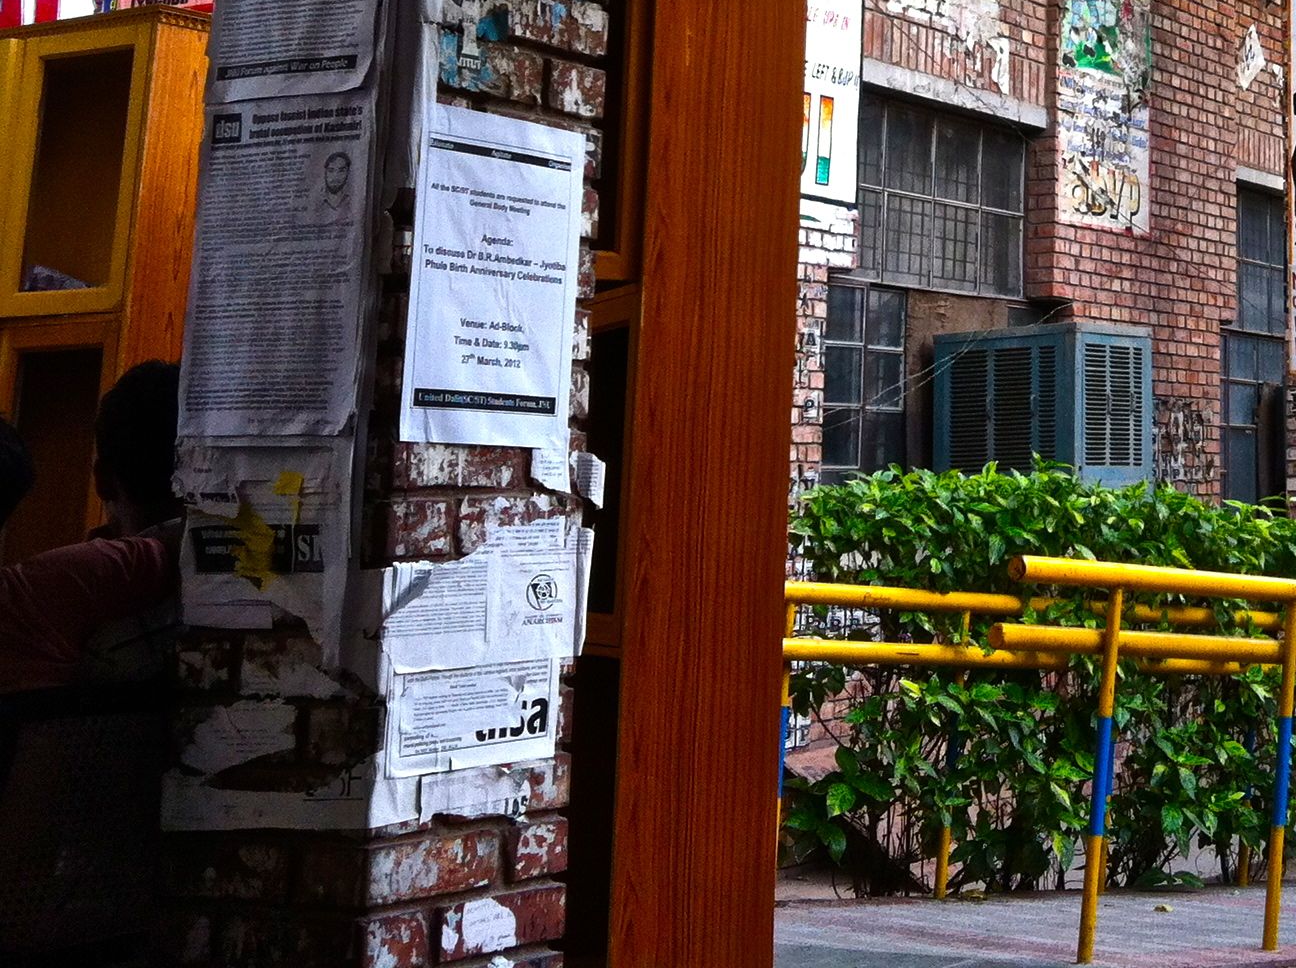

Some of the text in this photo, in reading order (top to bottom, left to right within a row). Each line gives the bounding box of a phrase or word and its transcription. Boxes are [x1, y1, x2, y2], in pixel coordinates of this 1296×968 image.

[431, 182, 440, 190] All
[441, 184, 450, 192] the
[470, 189, 495, 199] students
[506, 194, 533, 206] requested
[540, 199, 556, 209] attend
[470, 199, 530, 216] General Body Meeting
[481, 234, 513, 247] Agenda:
[424, 245, 434, 255] To
[435, 247, 465, 259] discuss
[467, 250, 476, 259] Dr
[425, 259, 563, 285] Phule Birth Anniversary Celebrations
[460, 318, 487, 330] Venue:
[454, 336, 472, 347] Time
[475, 338, 480, 347] &
[482, 338, 502, 349] Date:
[504, 358, 521, 368] 2012
